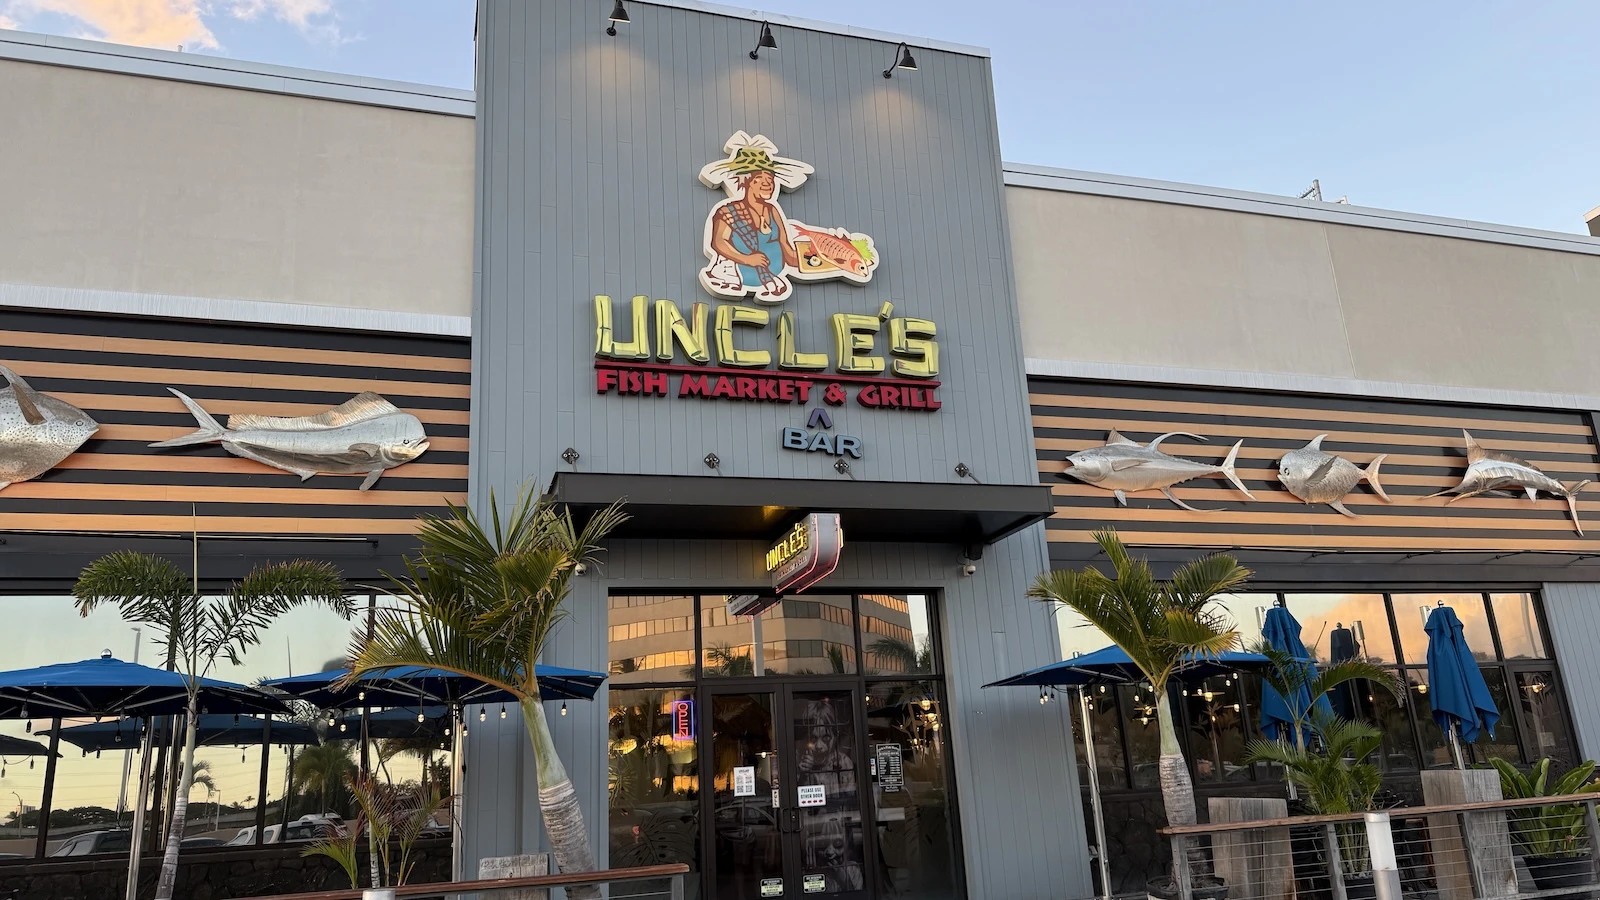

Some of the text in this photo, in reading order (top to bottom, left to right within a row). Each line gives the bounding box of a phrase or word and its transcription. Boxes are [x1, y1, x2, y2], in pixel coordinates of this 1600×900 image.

[594, 294, 940, 378] UNCLE'S
[597, 369, 942, 412] FISH MARKET & GRILL
[782, 426, 862, 459] BAR
[677, 702, 689, 738] OPEN
